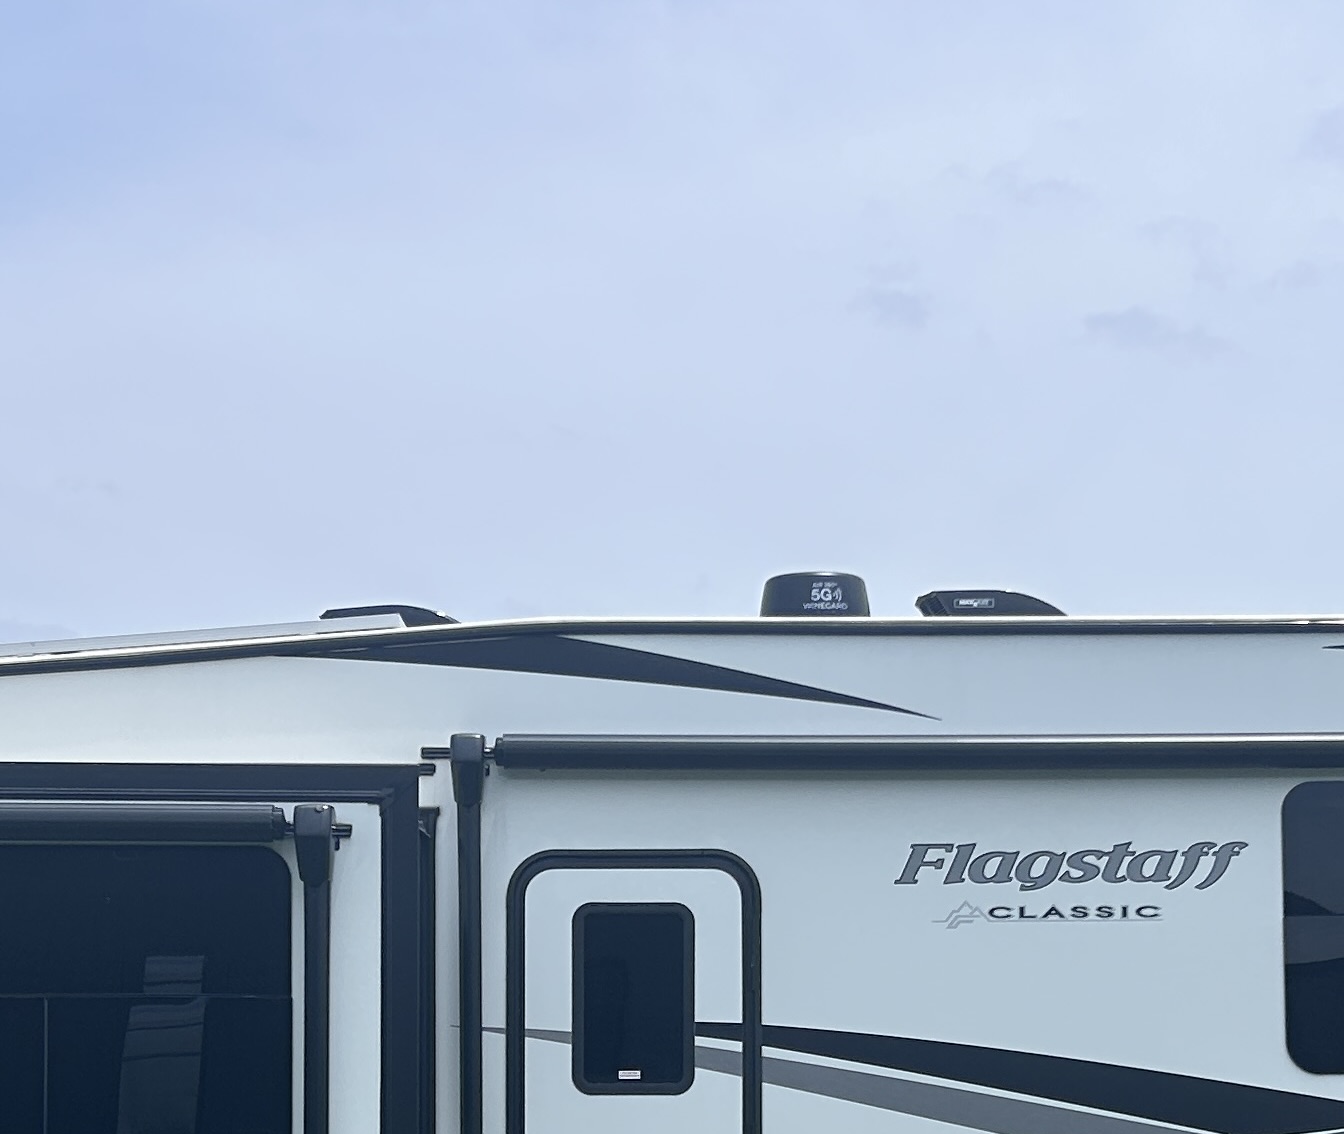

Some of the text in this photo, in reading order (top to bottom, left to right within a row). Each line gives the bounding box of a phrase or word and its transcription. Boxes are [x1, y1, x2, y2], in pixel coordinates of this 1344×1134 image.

[811, 589, 832, 601] 5G
[893, 841, 1249, 891] Flagstaff
[988, 904, 1162, 919] CLASSIC
